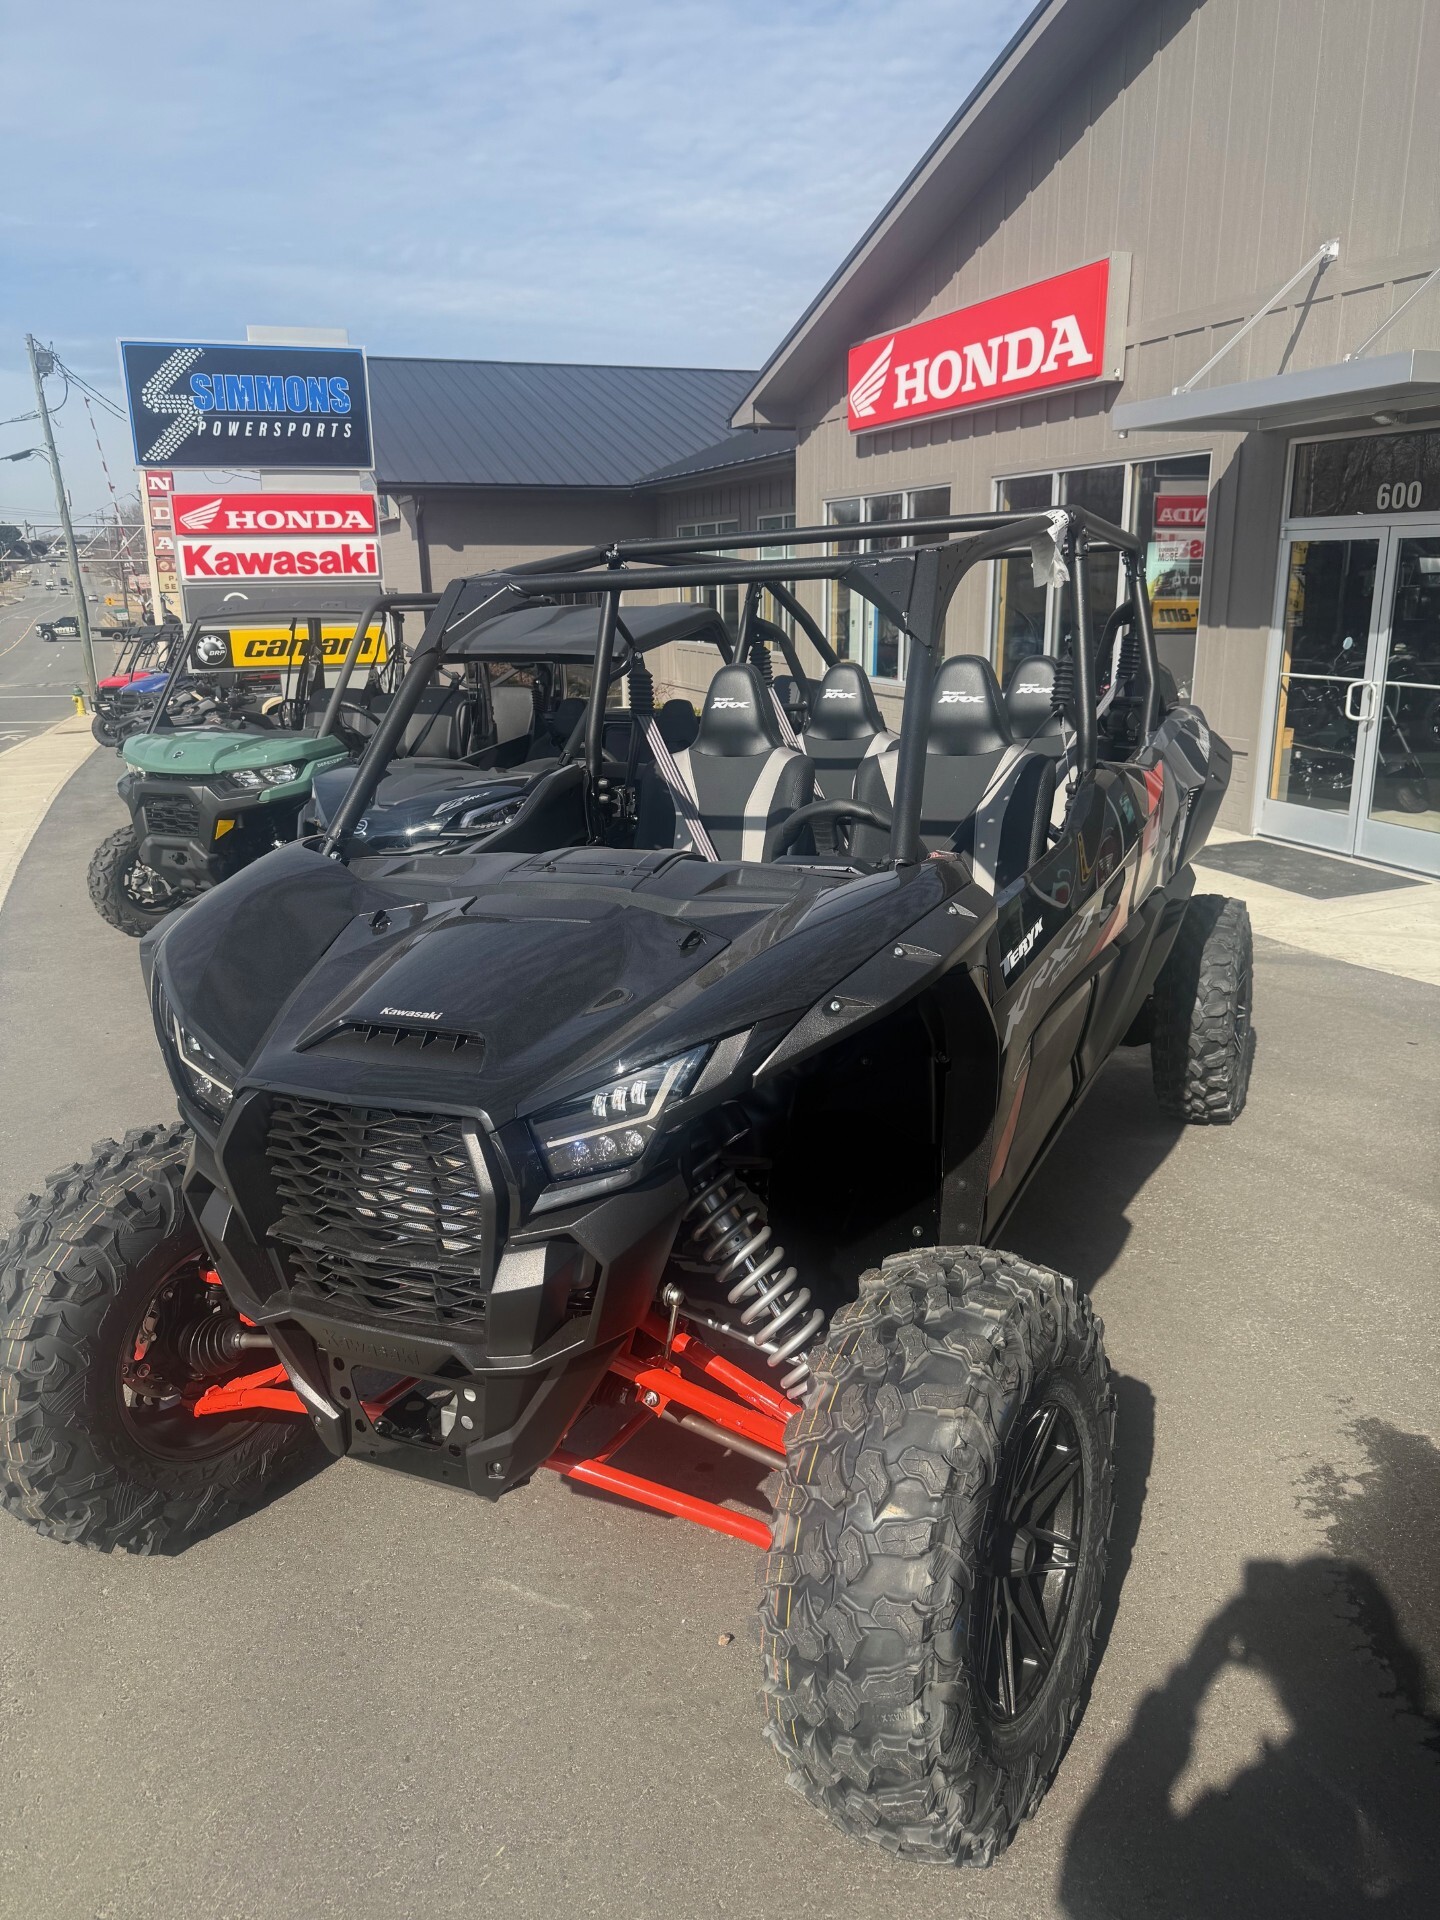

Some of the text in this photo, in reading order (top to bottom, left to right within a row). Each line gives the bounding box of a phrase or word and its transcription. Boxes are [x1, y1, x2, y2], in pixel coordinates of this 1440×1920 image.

[893, 314, 1093, 410] HONDA
[189, 373, 352, 414] SIMMONS
[197, 420, 352, 438] POWERSPORTS
[1376, 480, 1423, 510] 600
[224, 509, 373, 530] HONDA
[182, 543, 377, 577] Kawasaki
[244, 637, 373, 658] canam
[710, 701, 750, 709] KRX
[937, 695, 985, 704] KRX
[379, 1006, 443, 1020] Kawasaki
